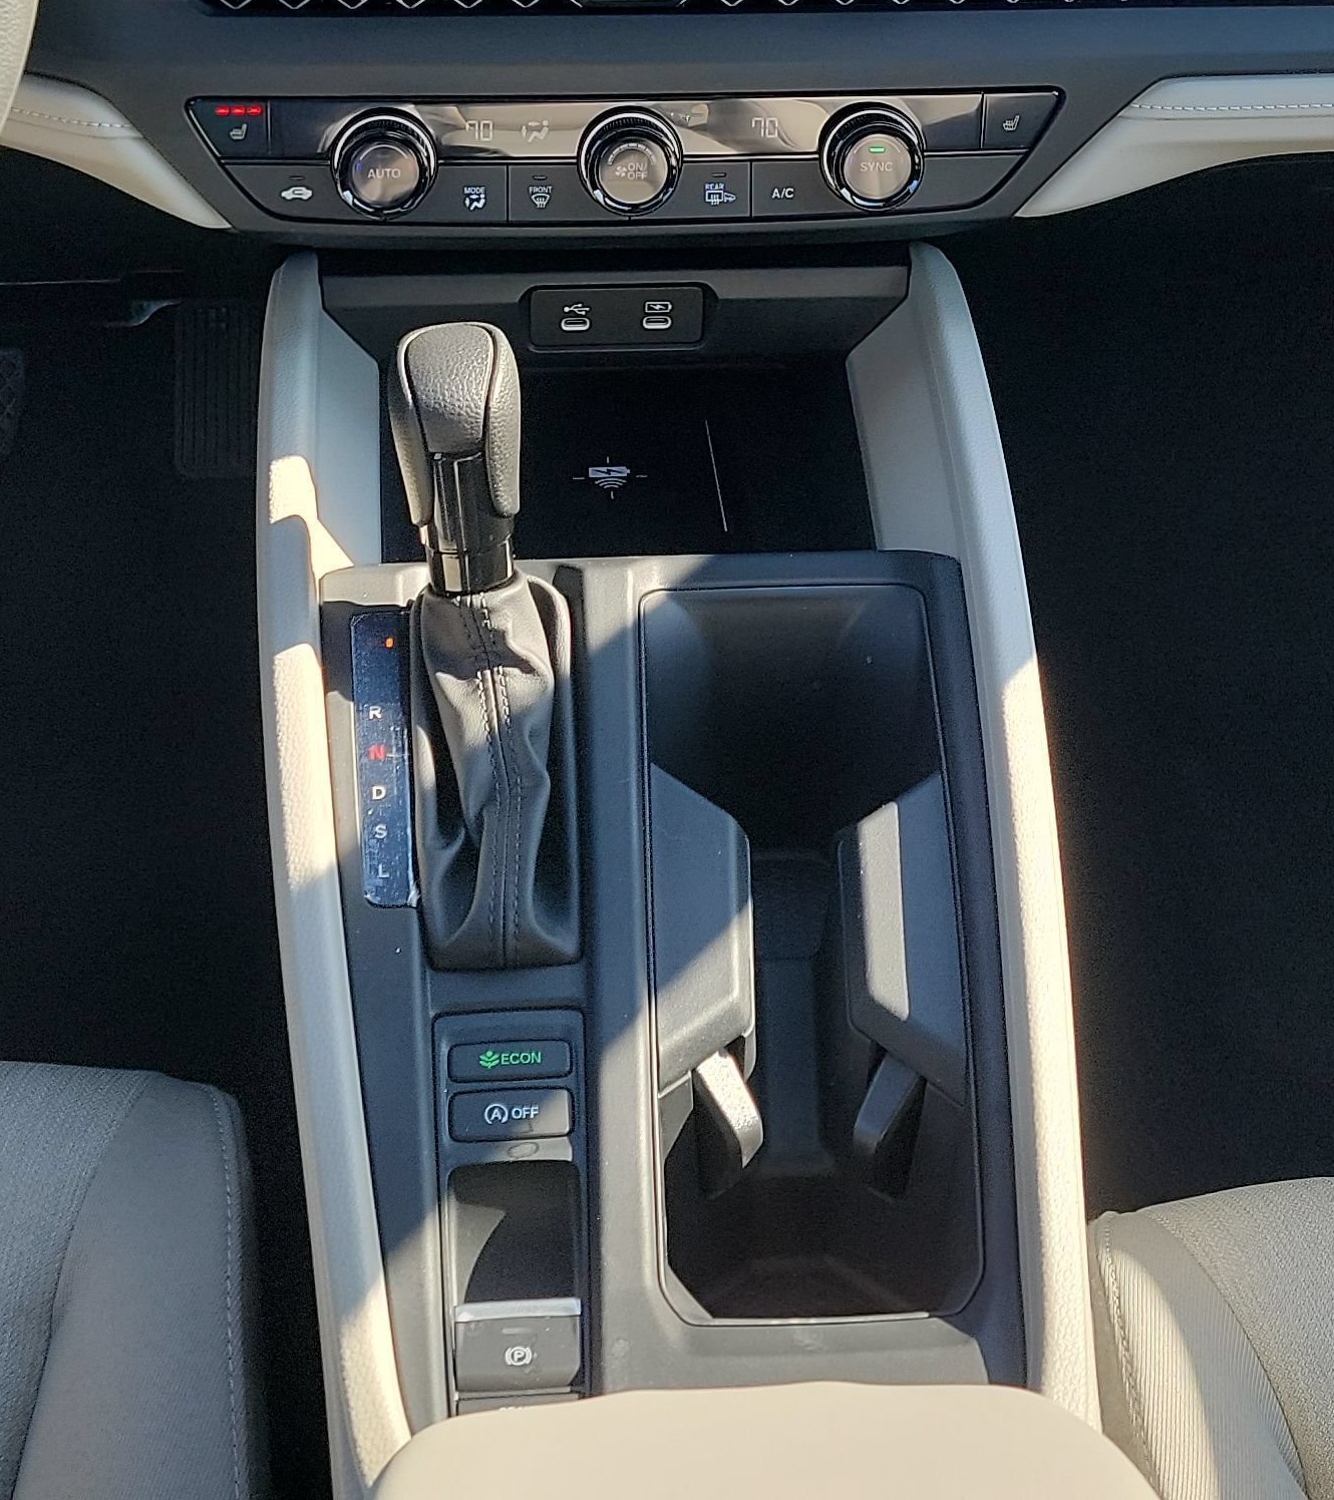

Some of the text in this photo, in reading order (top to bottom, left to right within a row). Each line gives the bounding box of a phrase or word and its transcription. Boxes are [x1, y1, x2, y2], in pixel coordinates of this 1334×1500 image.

[627, 162, 648, 171] ON/
[859, 161, 893, 173] SYNC
[367, 168, 401, 179] AUTO
[627, 171, 648, 181] OFF
[464, 187, 485, 195] MODE
[529, 186, 553, 194] FRONT
[772, 187, 795, 199] A/C
[369, 706, 381, 719] R
[368, 745, 385, 760] N
[372, 785, 386, 800] D
[375, 823, 386, 838] S
[378, 863, 389, 878] L
[501, 1052, 541, 1065] ECON
[511, 1106, 539, 1119] OFF
